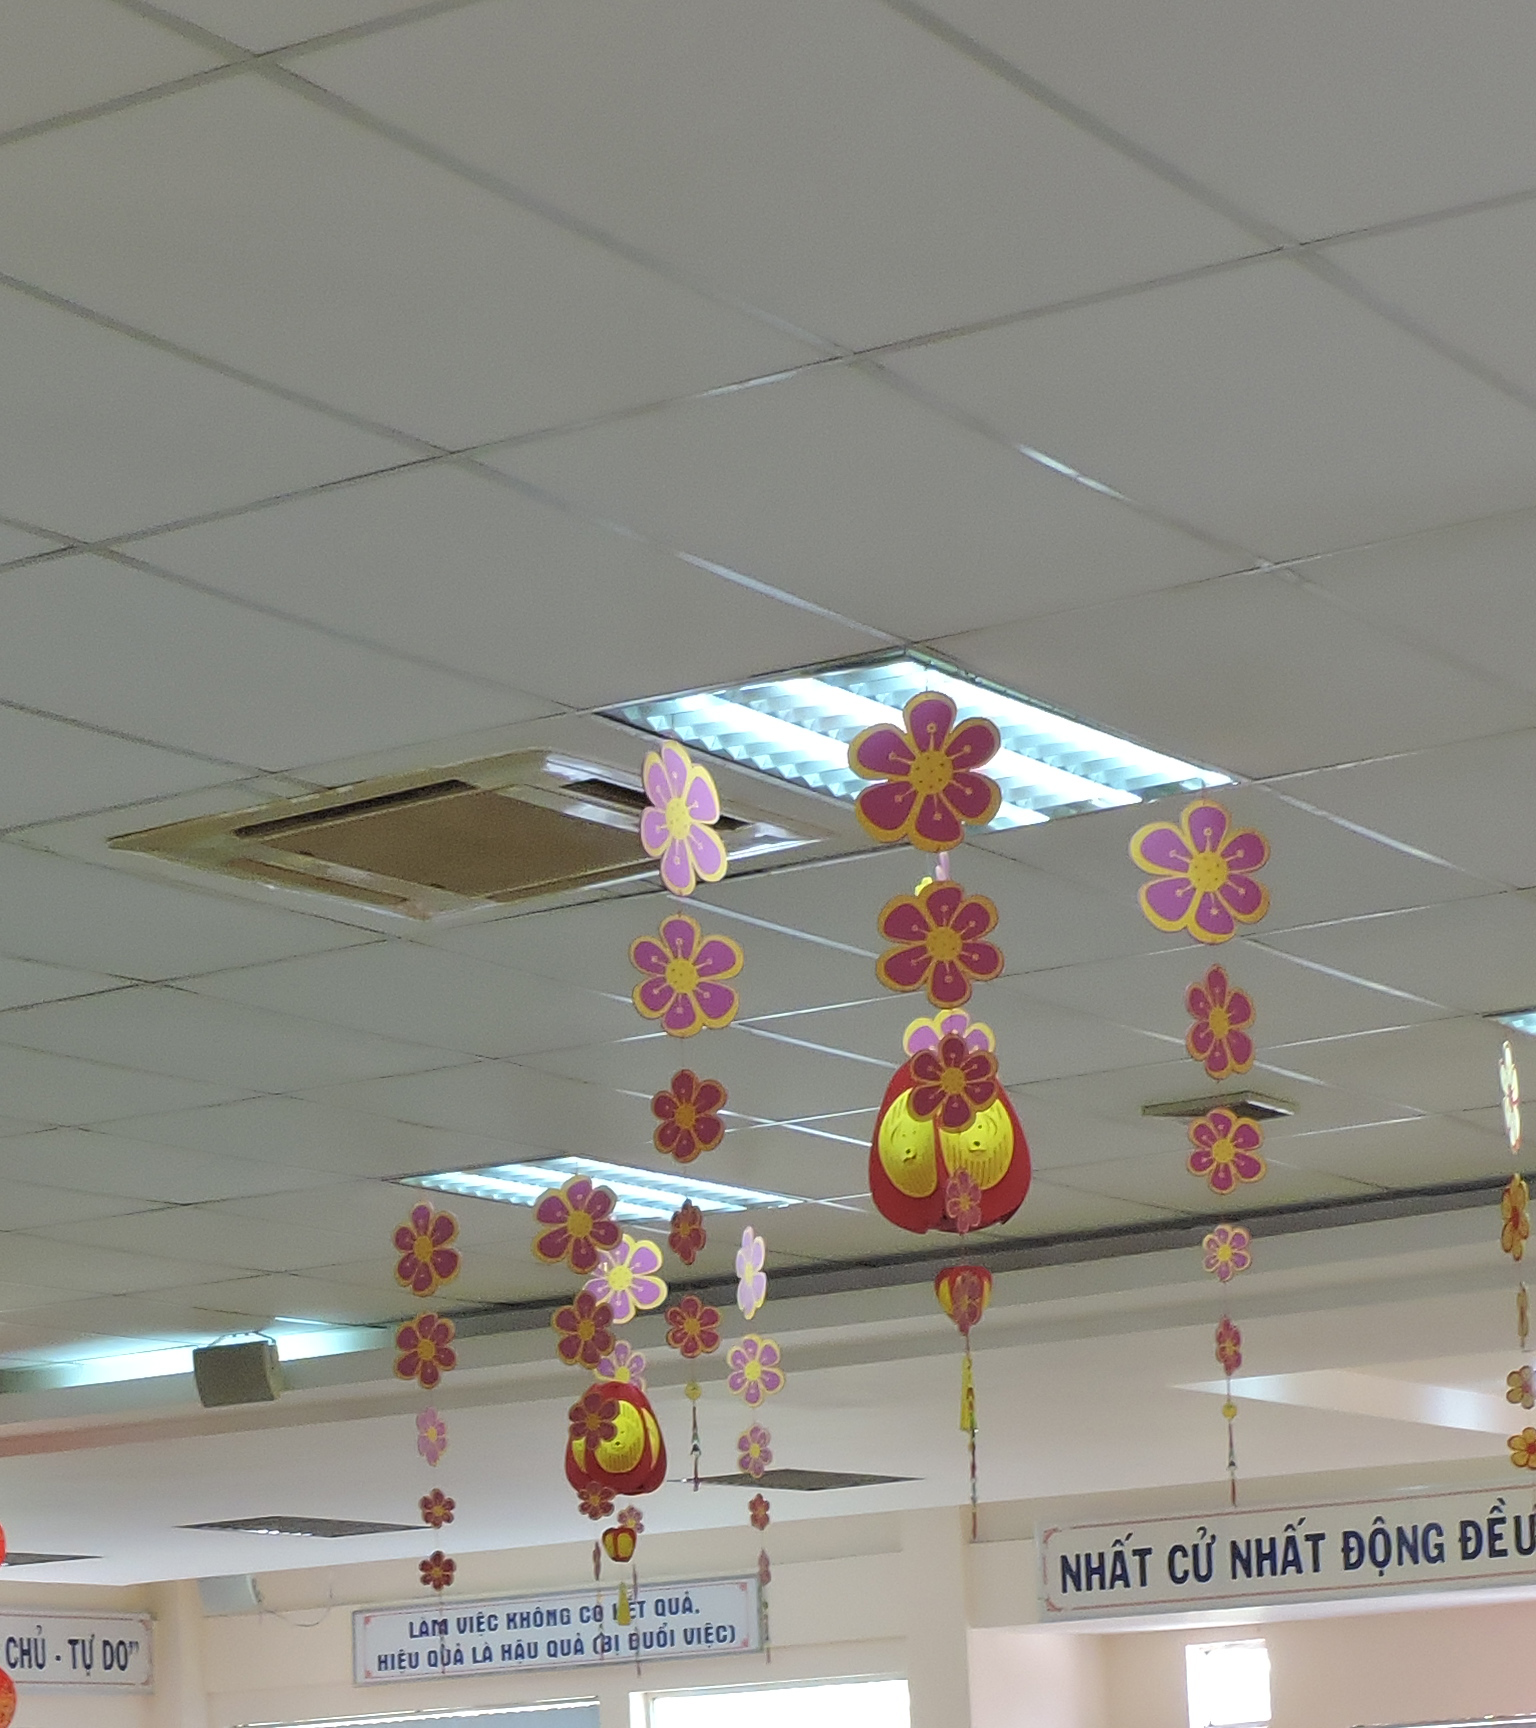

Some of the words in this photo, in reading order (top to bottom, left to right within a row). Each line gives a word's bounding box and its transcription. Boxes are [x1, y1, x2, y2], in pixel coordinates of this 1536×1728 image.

[1060, 1532, 1153, 1593] NHẤT
[1168, 1526, 1216, 1585] CỬ
[1230, 1517, 1326, 1580] NHẤT
[1341, 1515, 1446, 1577] ĐỘNG
[409, 1616, 449, 1639] LÀM
[456, 1611, 499, 1637] VIỆC
[506, 1606, 572, 1631] KHÔNG
[5, 1624, 46, 1669] CHỦ
[67, 1633, 95, 1676] TỰ
[472, 1641, 493, 1664] LÀ
[500, 1639, 539, 1664] HẬU
